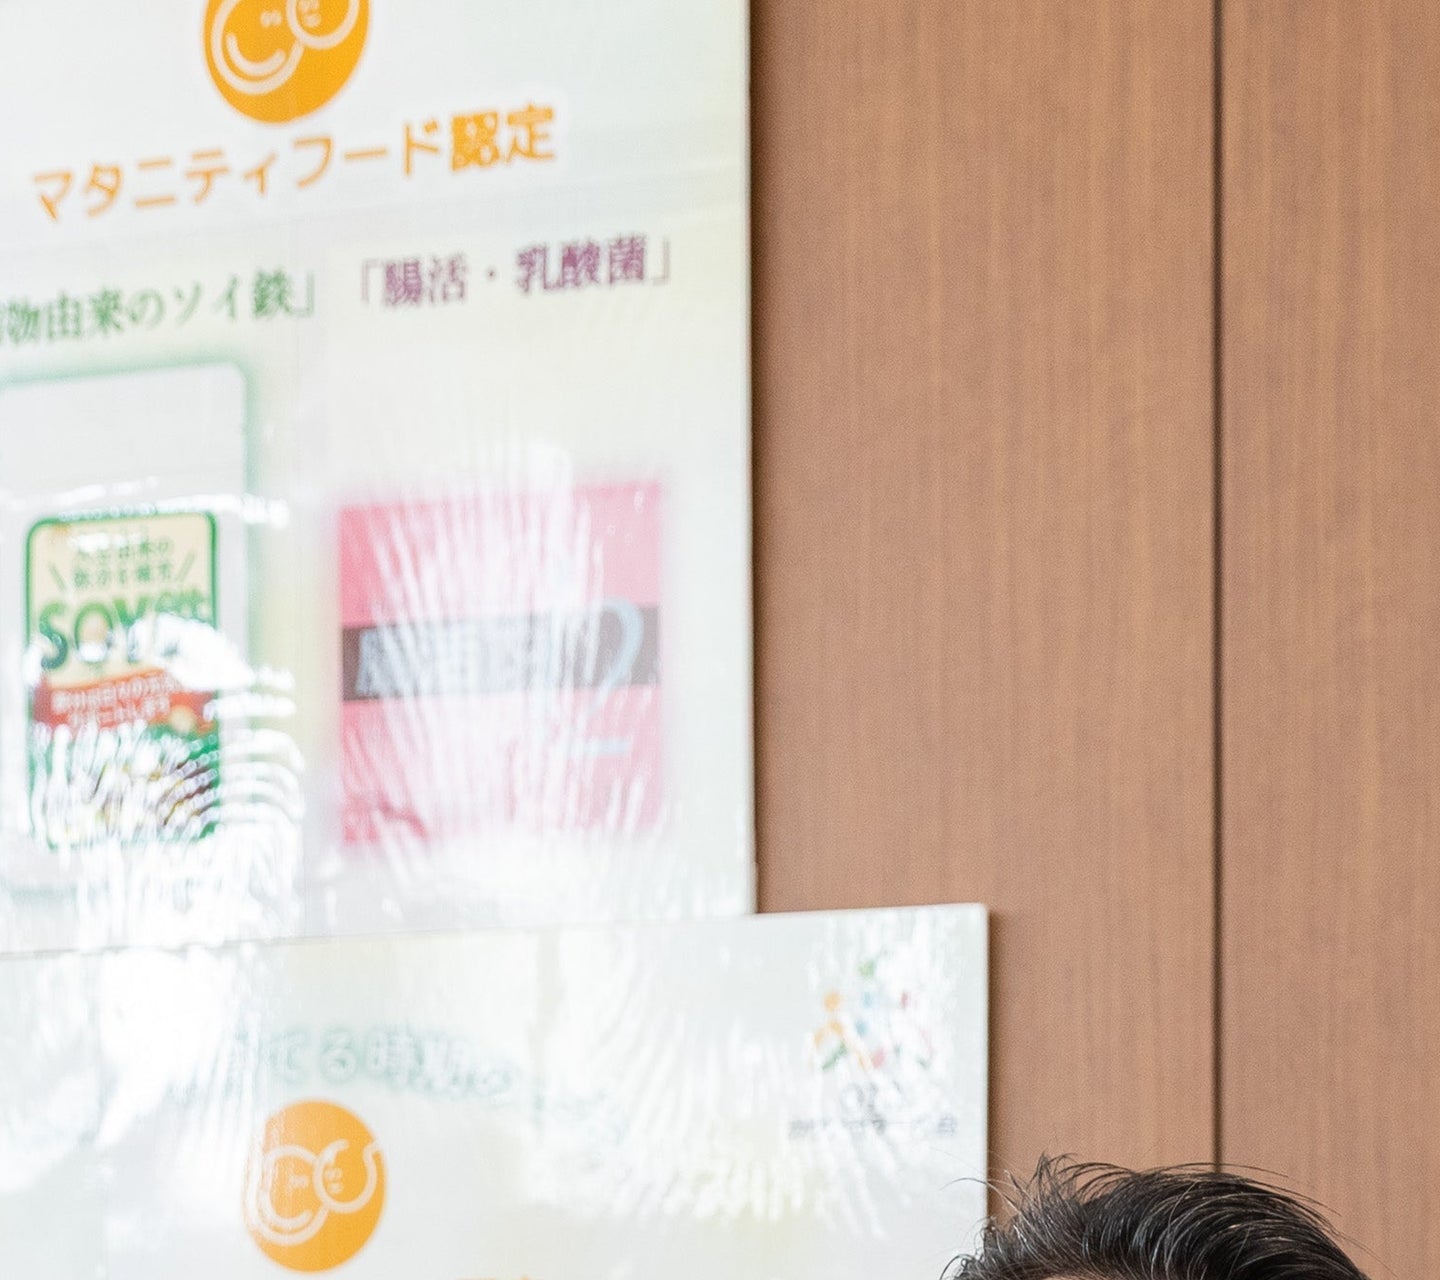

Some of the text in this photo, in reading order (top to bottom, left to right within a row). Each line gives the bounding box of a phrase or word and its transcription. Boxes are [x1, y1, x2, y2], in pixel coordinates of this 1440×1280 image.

[31, 101, 557, 223] マタニティフード認定
